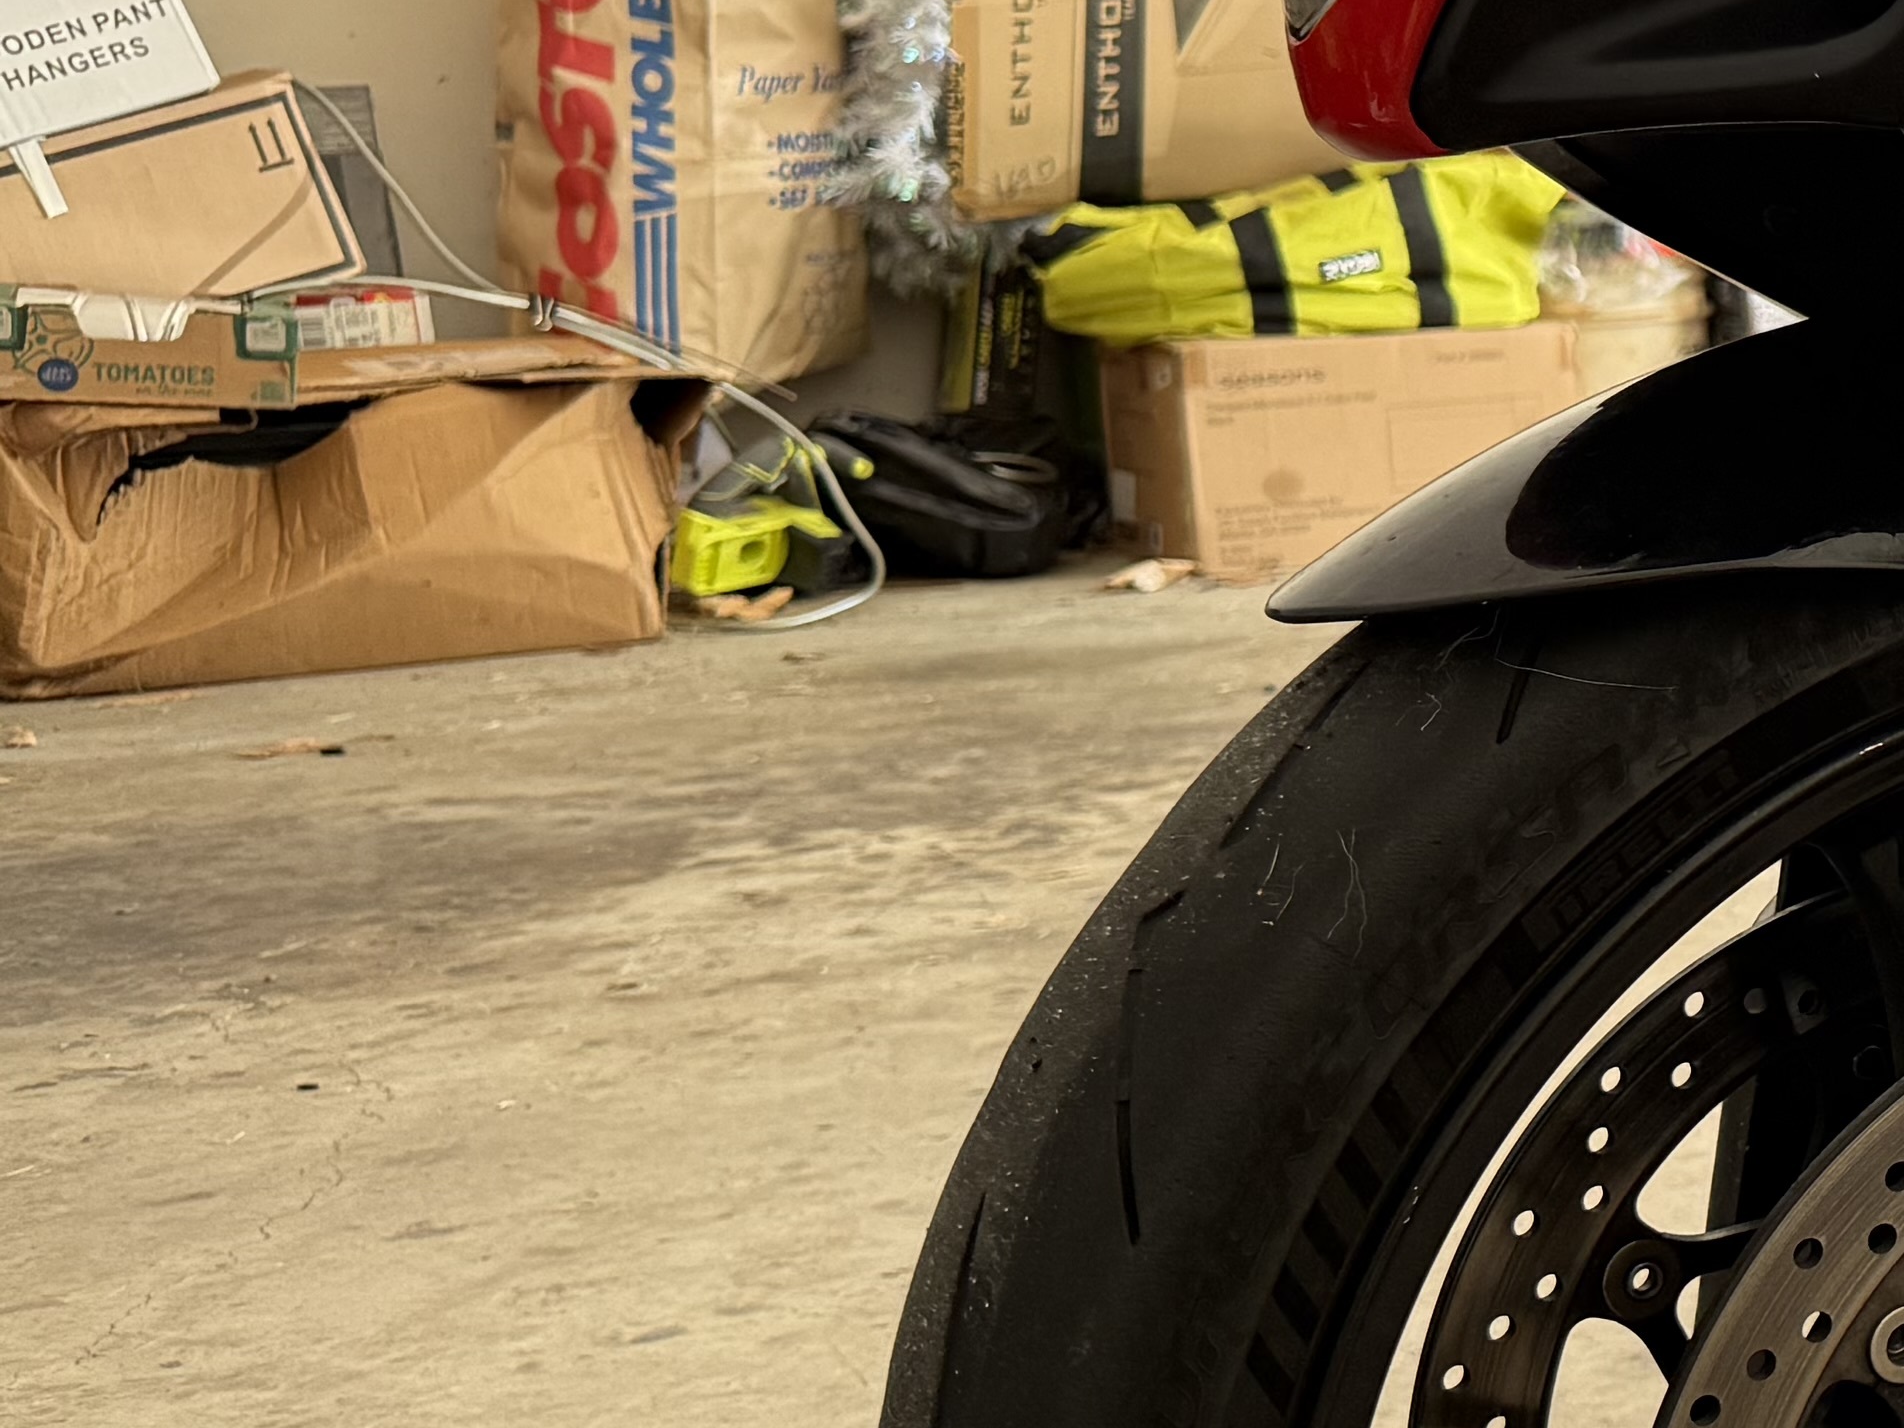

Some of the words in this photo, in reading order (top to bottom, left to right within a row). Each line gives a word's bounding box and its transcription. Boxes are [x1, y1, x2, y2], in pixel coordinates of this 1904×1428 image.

[0, 18, 88, 56] ODEN
[1, 36, 150, 91] HANGERS
[737, 65, 804, 102] Paper
[93, 361, 216, 388] TOMATOES
